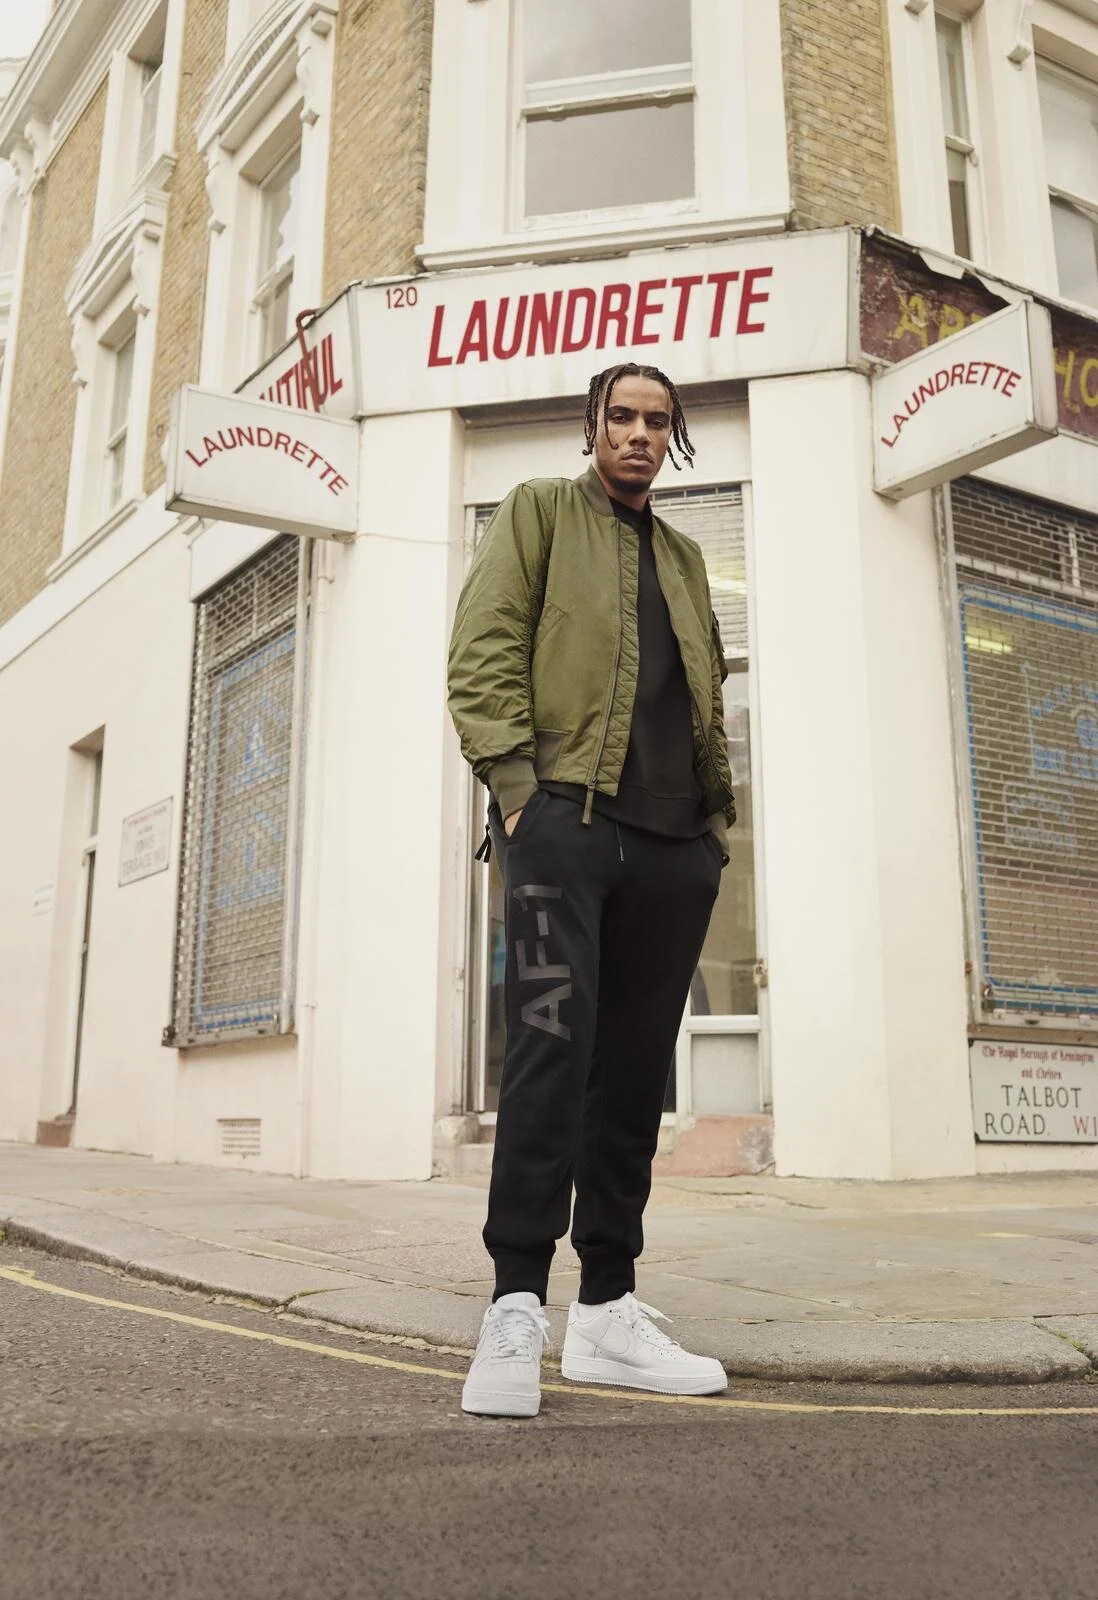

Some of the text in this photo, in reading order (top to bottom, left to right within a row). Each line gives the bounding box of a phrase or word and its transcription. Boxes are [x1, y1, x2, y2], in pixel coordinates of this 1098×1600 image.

[386, 286, 418, 309] 120
[427, 266, 774, 368] LAUNDRETTE
[881, 361, 1022, 448] LAUNDRETTE
[185, 426, 349, 496] LAUNDRETTE
[513, 884, 572, 1041] AF-1
[982, 1045, 996, 1057] The
[998, 1046, 1018, 1062] Royal
[1020, 1048, 1048, 1063] Borough
[1051, 1050, 1058, 1060] of
[1021, 1068, 1033, 1078] and
[1001, 1085, 1082, 1108] TALBOT
